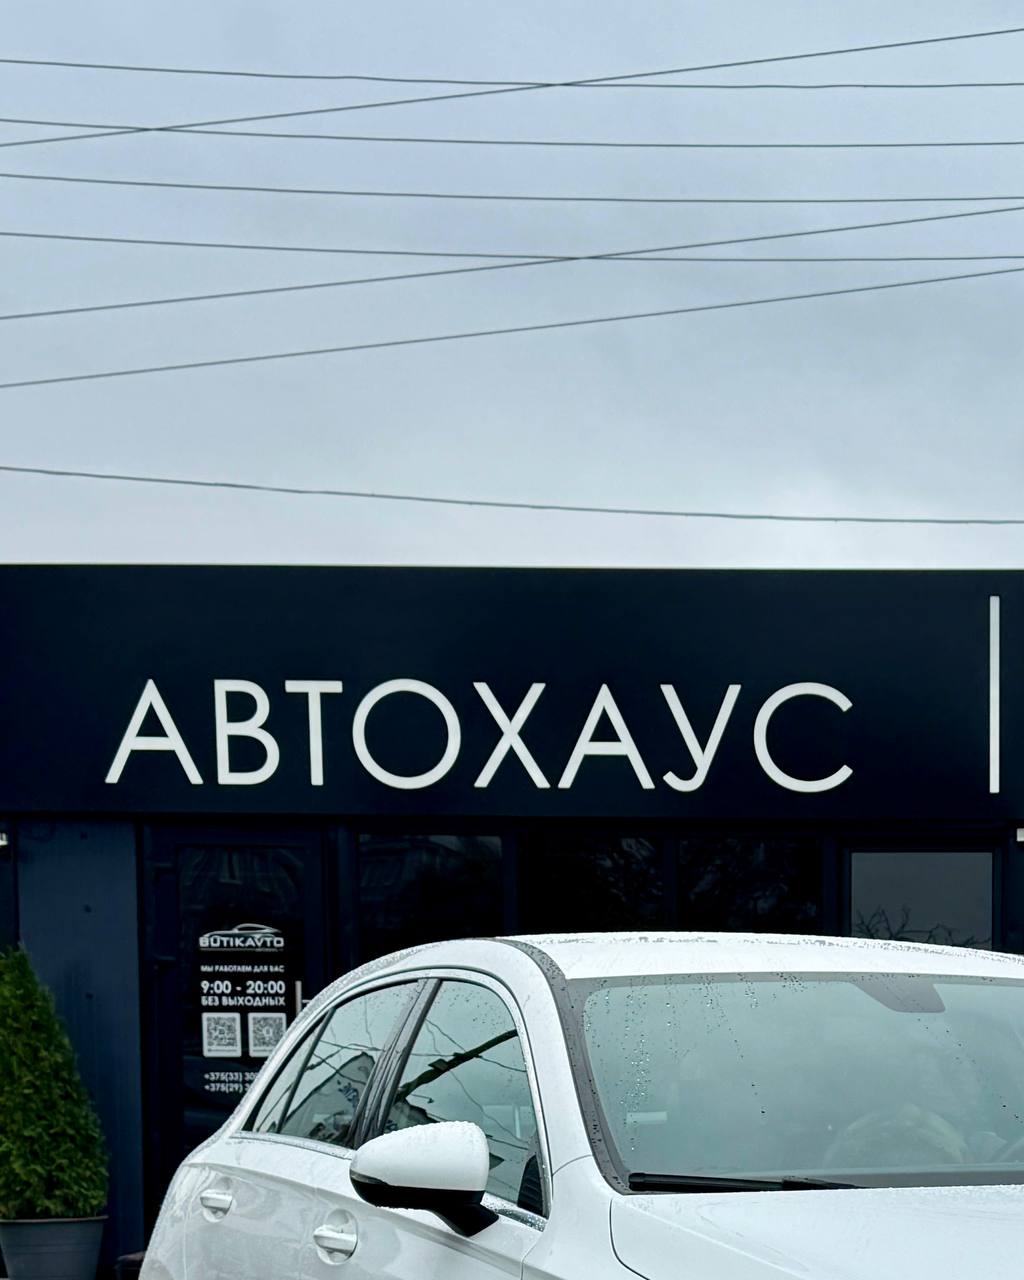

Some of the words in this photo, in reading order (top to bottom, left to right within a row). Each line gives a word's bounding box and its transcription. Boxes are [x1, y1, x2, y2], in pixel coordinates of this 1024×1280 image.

[104, 678, 854, 793] АВТОХАУС
[199, 936, 284, 948] BUTIKAVTO
[200, 980, 232, 994] 9:00
[246, 980, 286, 994] 20:00
[200, 996, 219, 1006] БЕЗ
[221, 996, 286, 1006] ВЫХОДНЫХ
